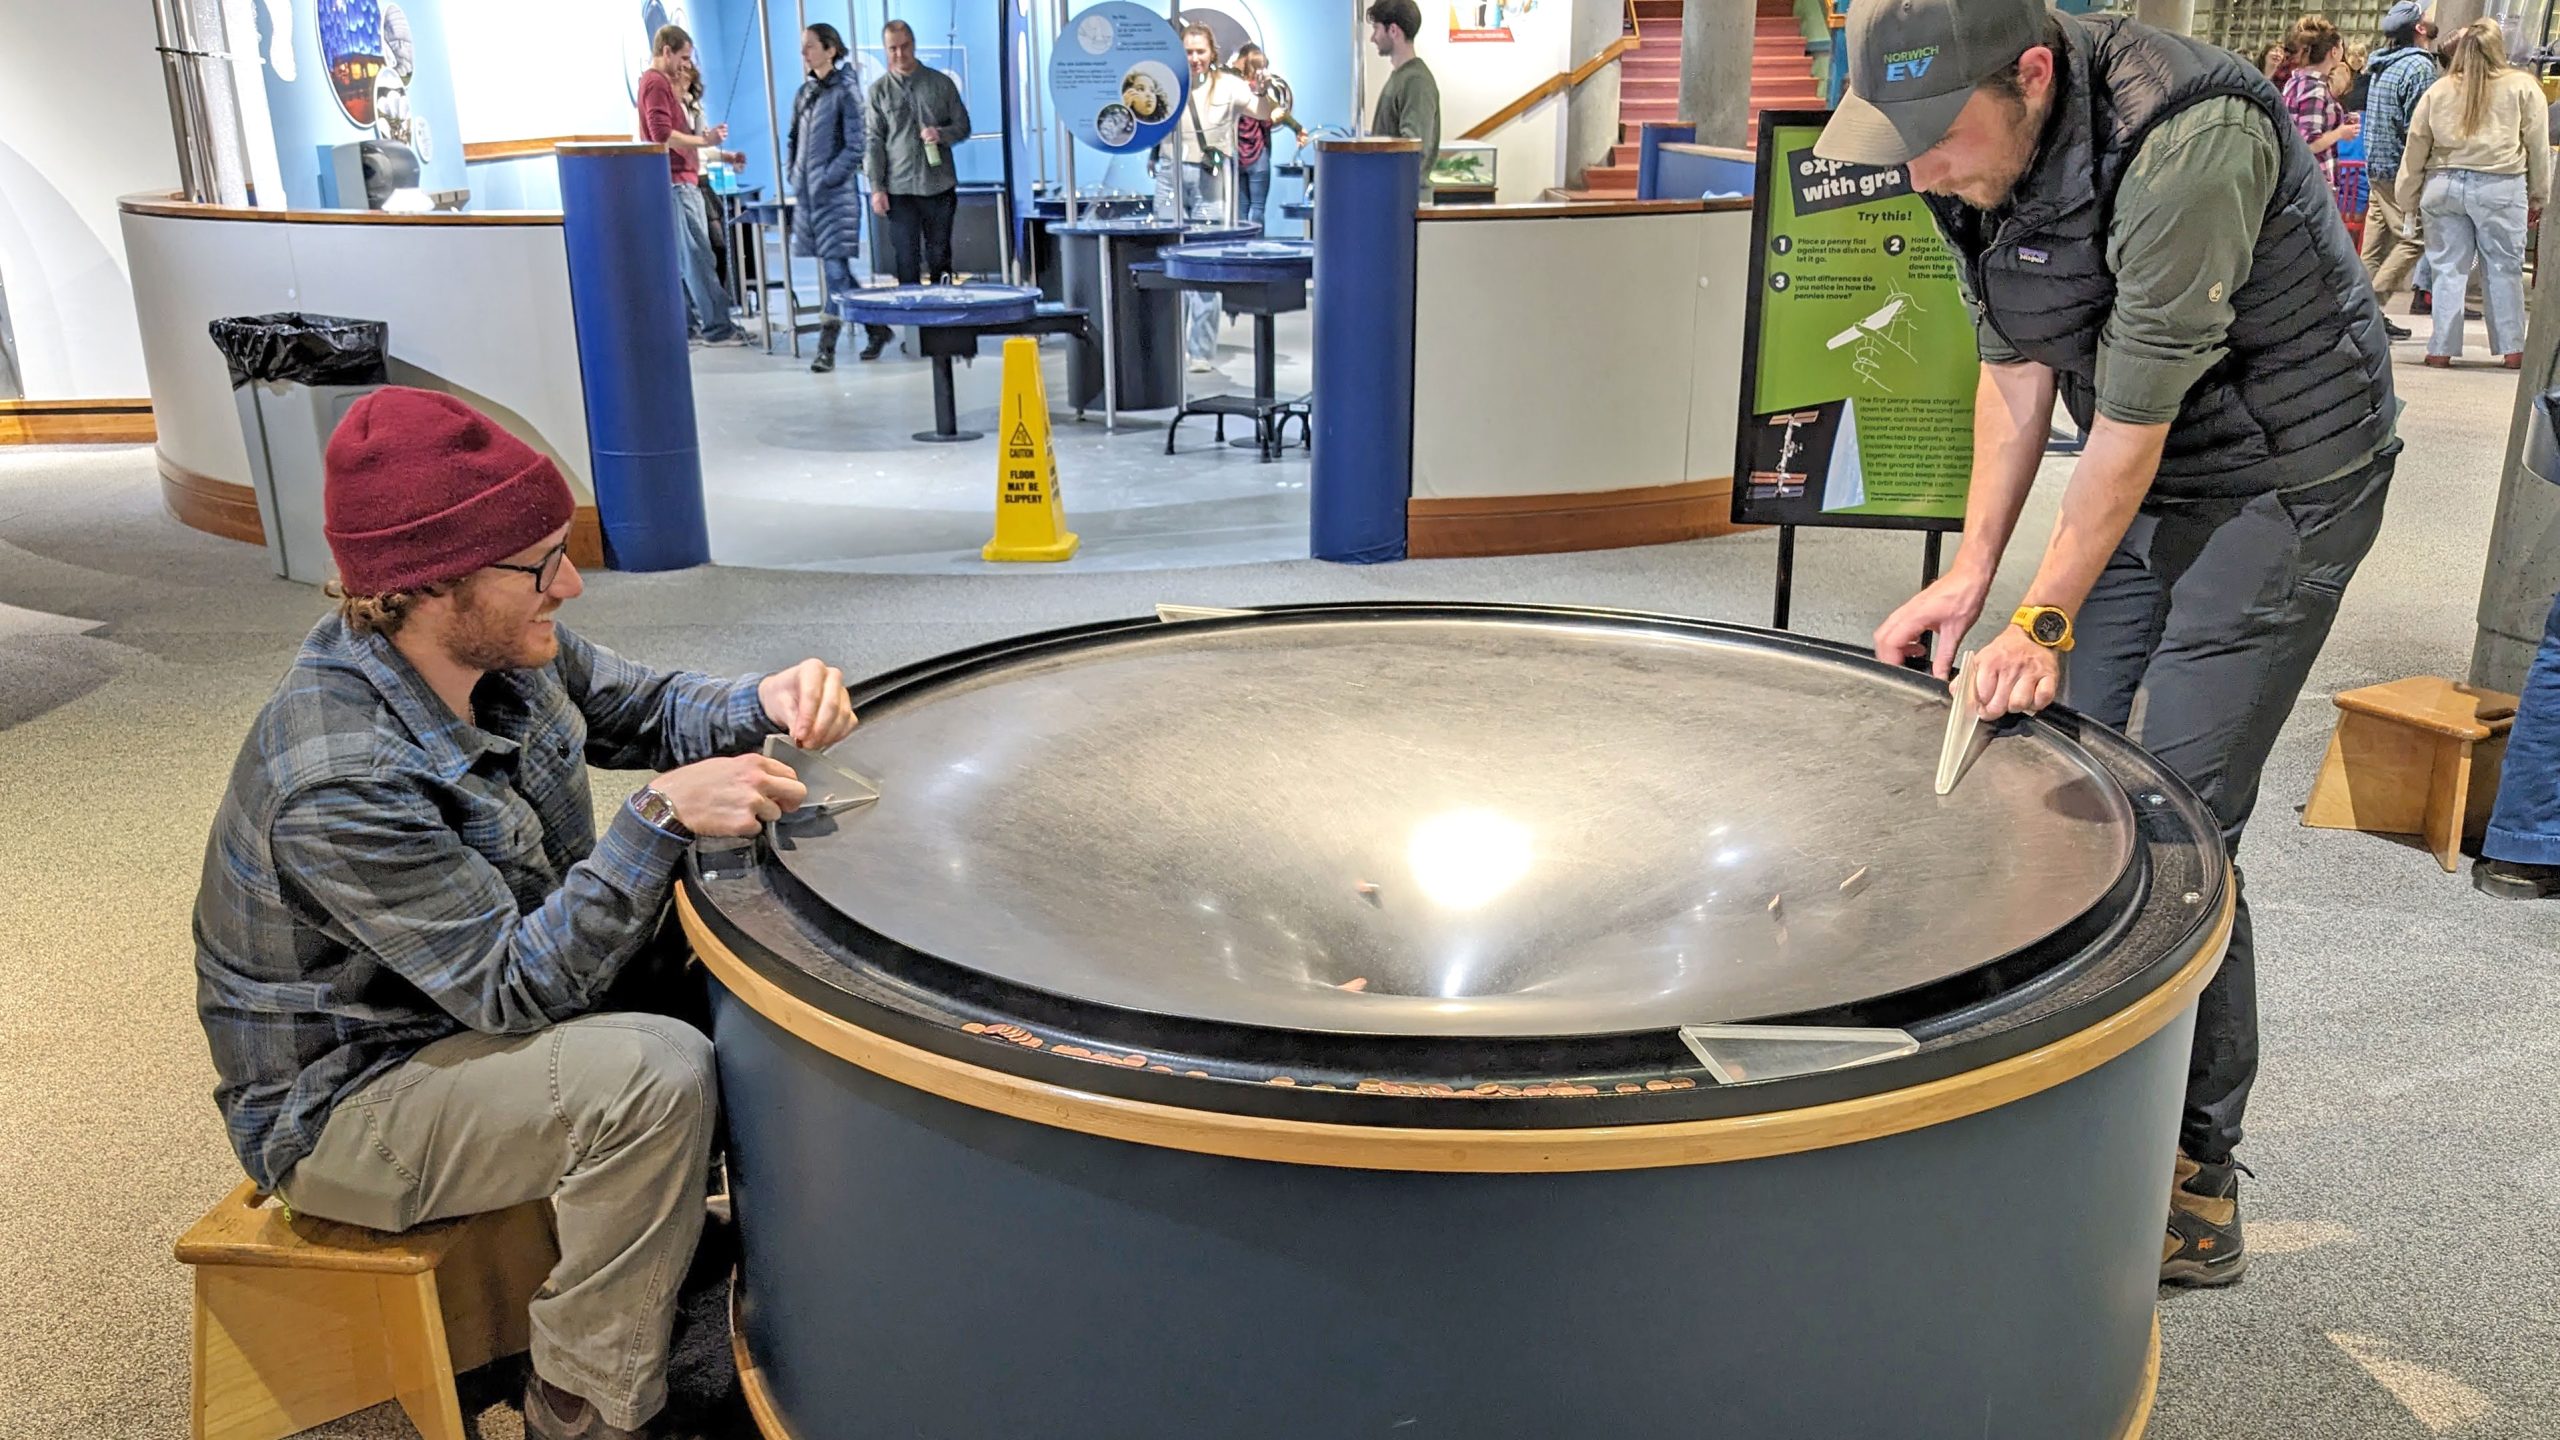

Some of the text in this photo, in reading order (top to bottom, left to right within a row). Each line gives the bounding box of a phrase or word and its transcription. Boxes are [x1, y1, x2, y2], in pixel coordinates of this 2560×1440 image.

[1884, 45, 1939, 63] NORWICH
[1886, 56, 1935, 82] EV
[1800, 159, 1854, 176] exp
[1802, 169, 1901, 203] with gra
[1857, 210, 1912, 224] Try this!
[1778, 238, 1786, 252] 1
[1827, 239, 1851, 247] penny
[1890, 238, 1900, 251] 2
[1797, 247, 1827, 255] against
[1910, 246, 1930, 254] edge
[1775, 275, 1785, 288] 3
[1009, 448, 1034, 458] CAUTION
[1010, 470, 1035, 479] FLOOR
[1008, 482, 1038, 491] MAY BE
[1004, 494, 1042, 503] SLIPPERY
